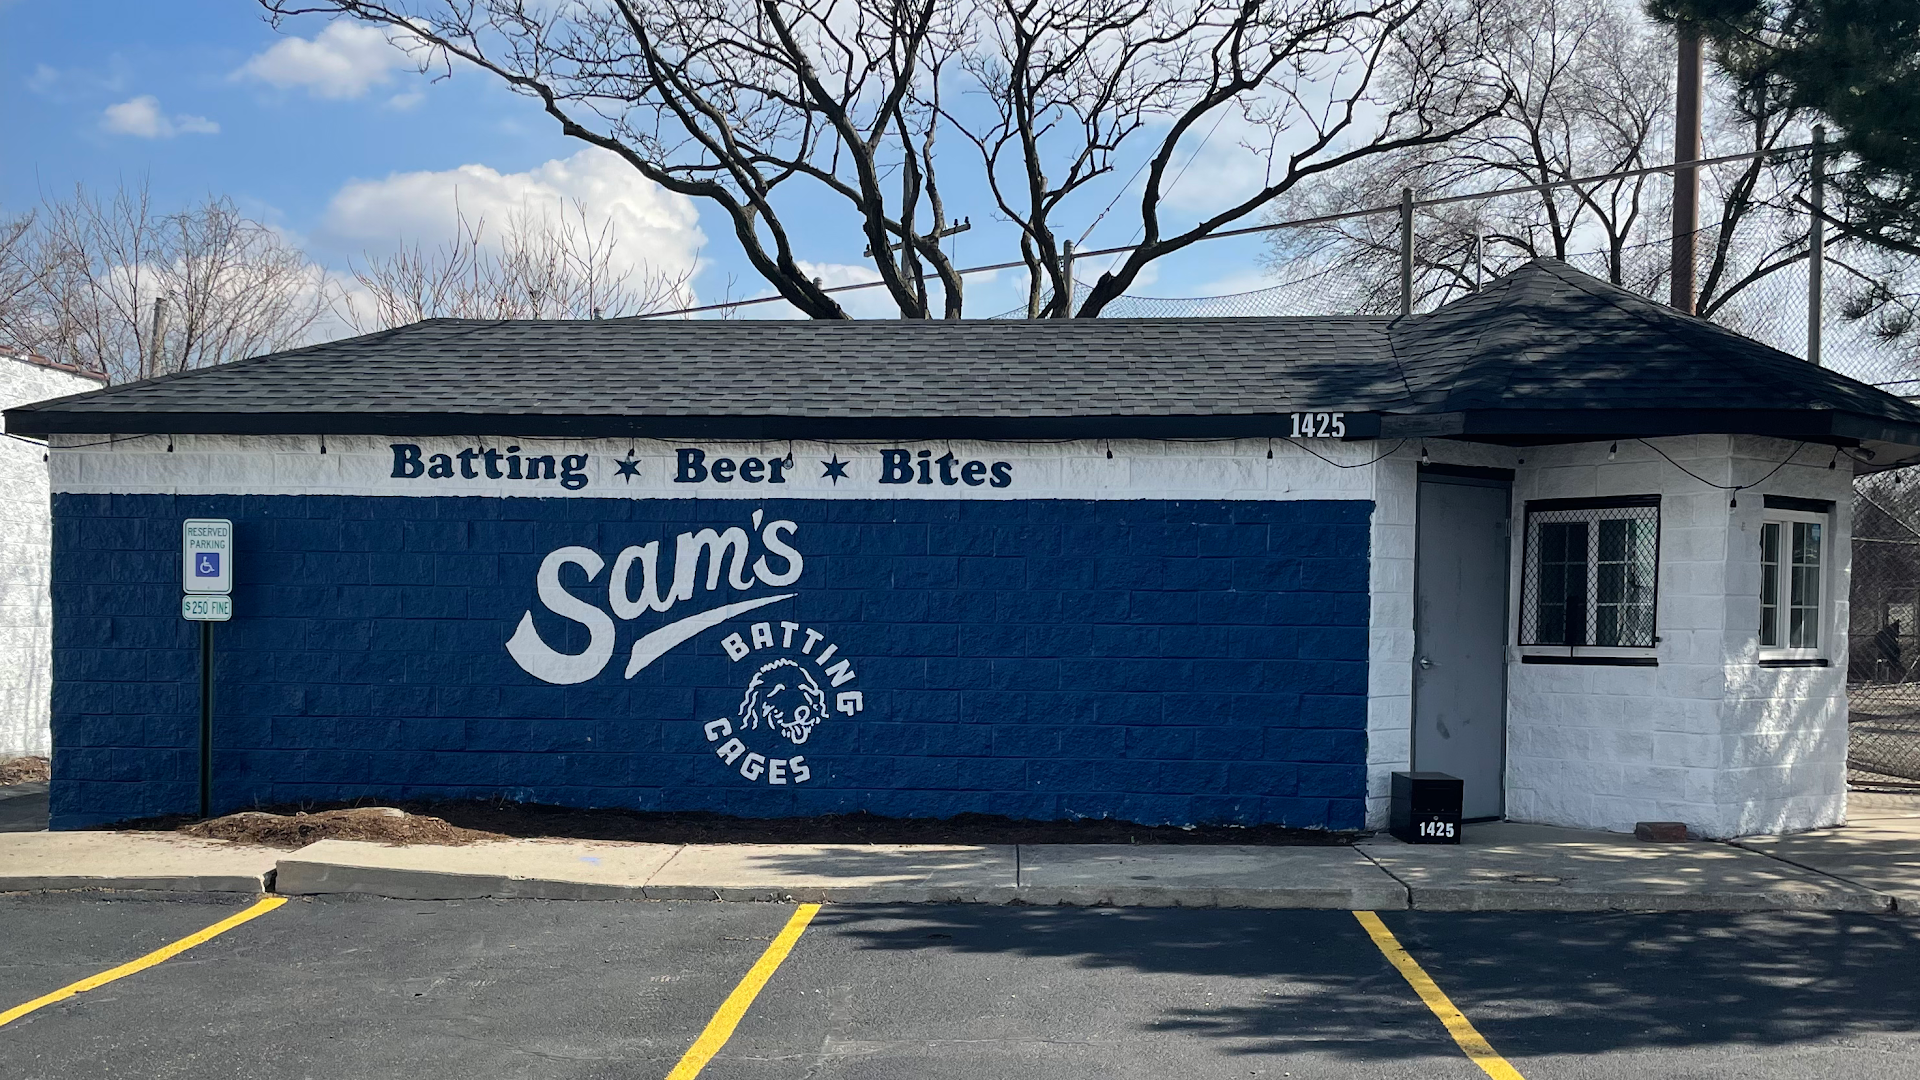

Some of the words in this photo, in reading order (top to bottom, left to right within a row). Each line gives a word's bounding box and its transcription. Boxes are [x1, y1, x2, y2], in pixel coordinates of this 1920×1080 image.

[1290, 412, 1346, 438] 1425
[390, 443, 589, 490] Batting
[673, 448, 793, 484] Beer
[878, 448, 1013, 488] Bites
[187, 527, 228, 537] RESERVED
[189, 539, 226, 549] PARKING
[184, 601, 209, 615] $250
[211, 601, 229, 615] FINE
[505, 508, 804, 685] Sam's
[720, 620, 864, 717] BATTING
[704, 717, 811, 785] CAGES
[1419, 821, 1455, 838] 1425
